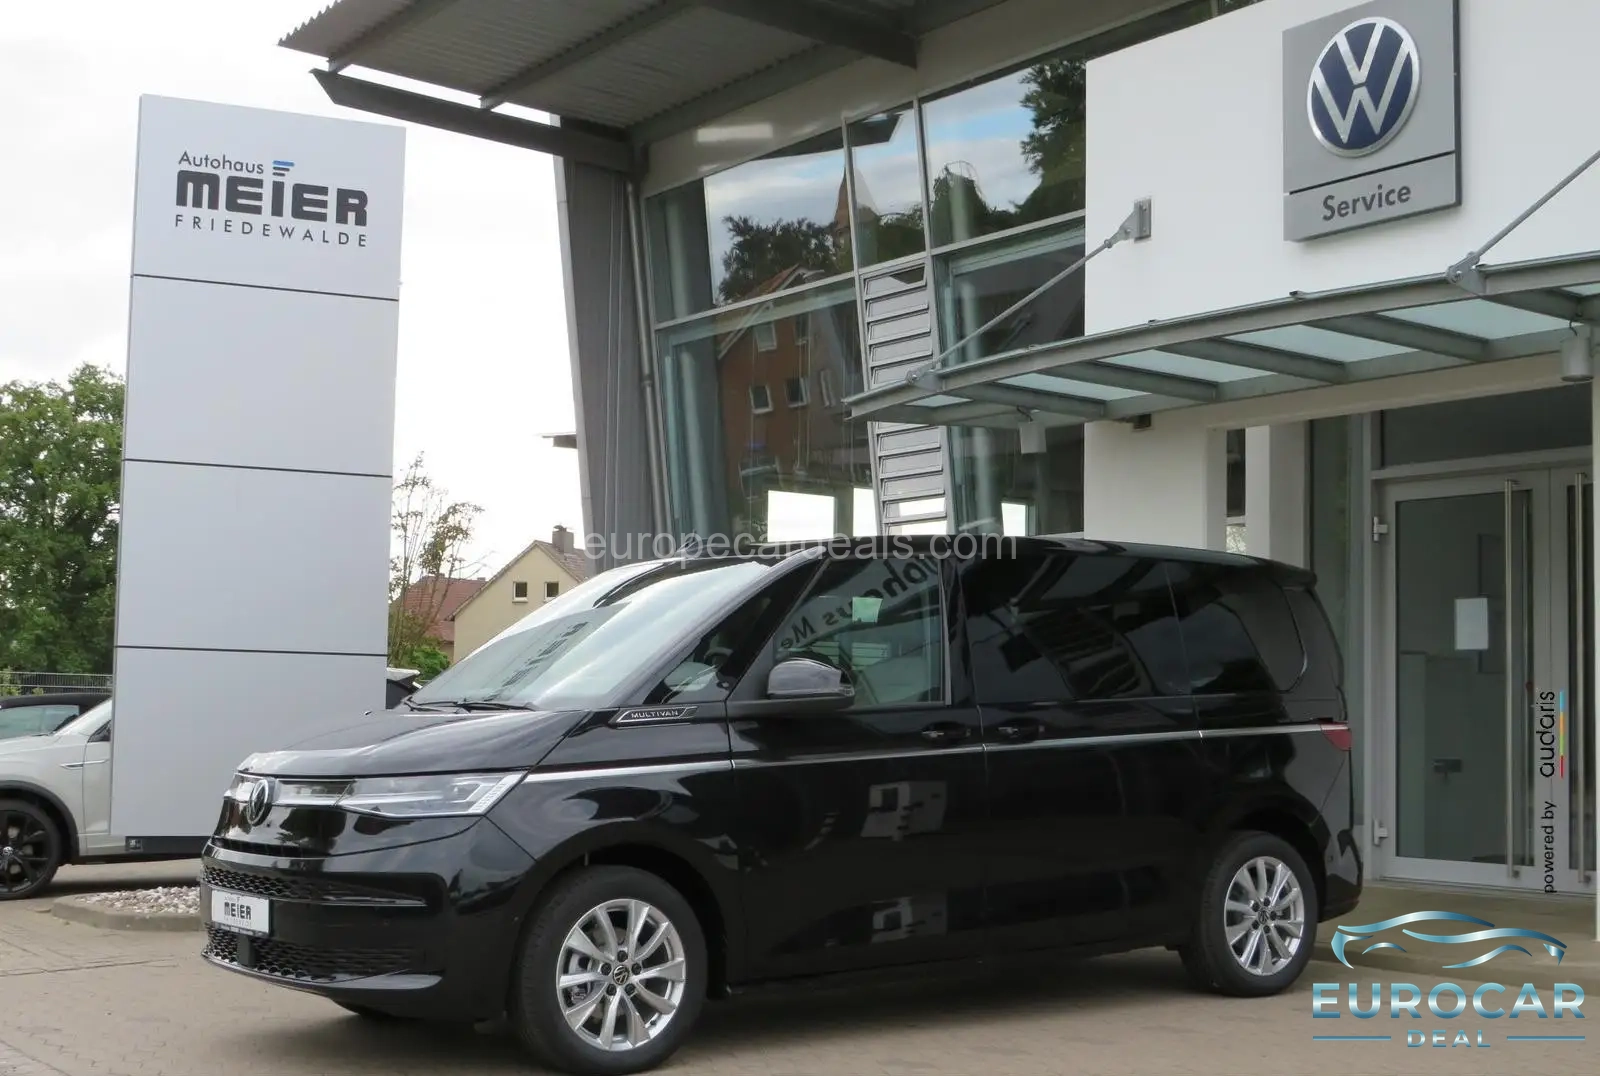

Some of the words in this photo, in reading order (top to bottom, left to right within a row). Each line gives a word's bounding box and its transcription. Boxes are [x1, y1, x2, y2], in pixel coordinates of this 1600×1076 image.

[178, 150, 264, 175] Autohaus
[175, 168, 368, 227] MEIER
[1322, 184, 1412, 221] Service
[175, 214, 367, 247] FRIEDEWALDE
[631, 710, 679, 719] MULTIVAN
